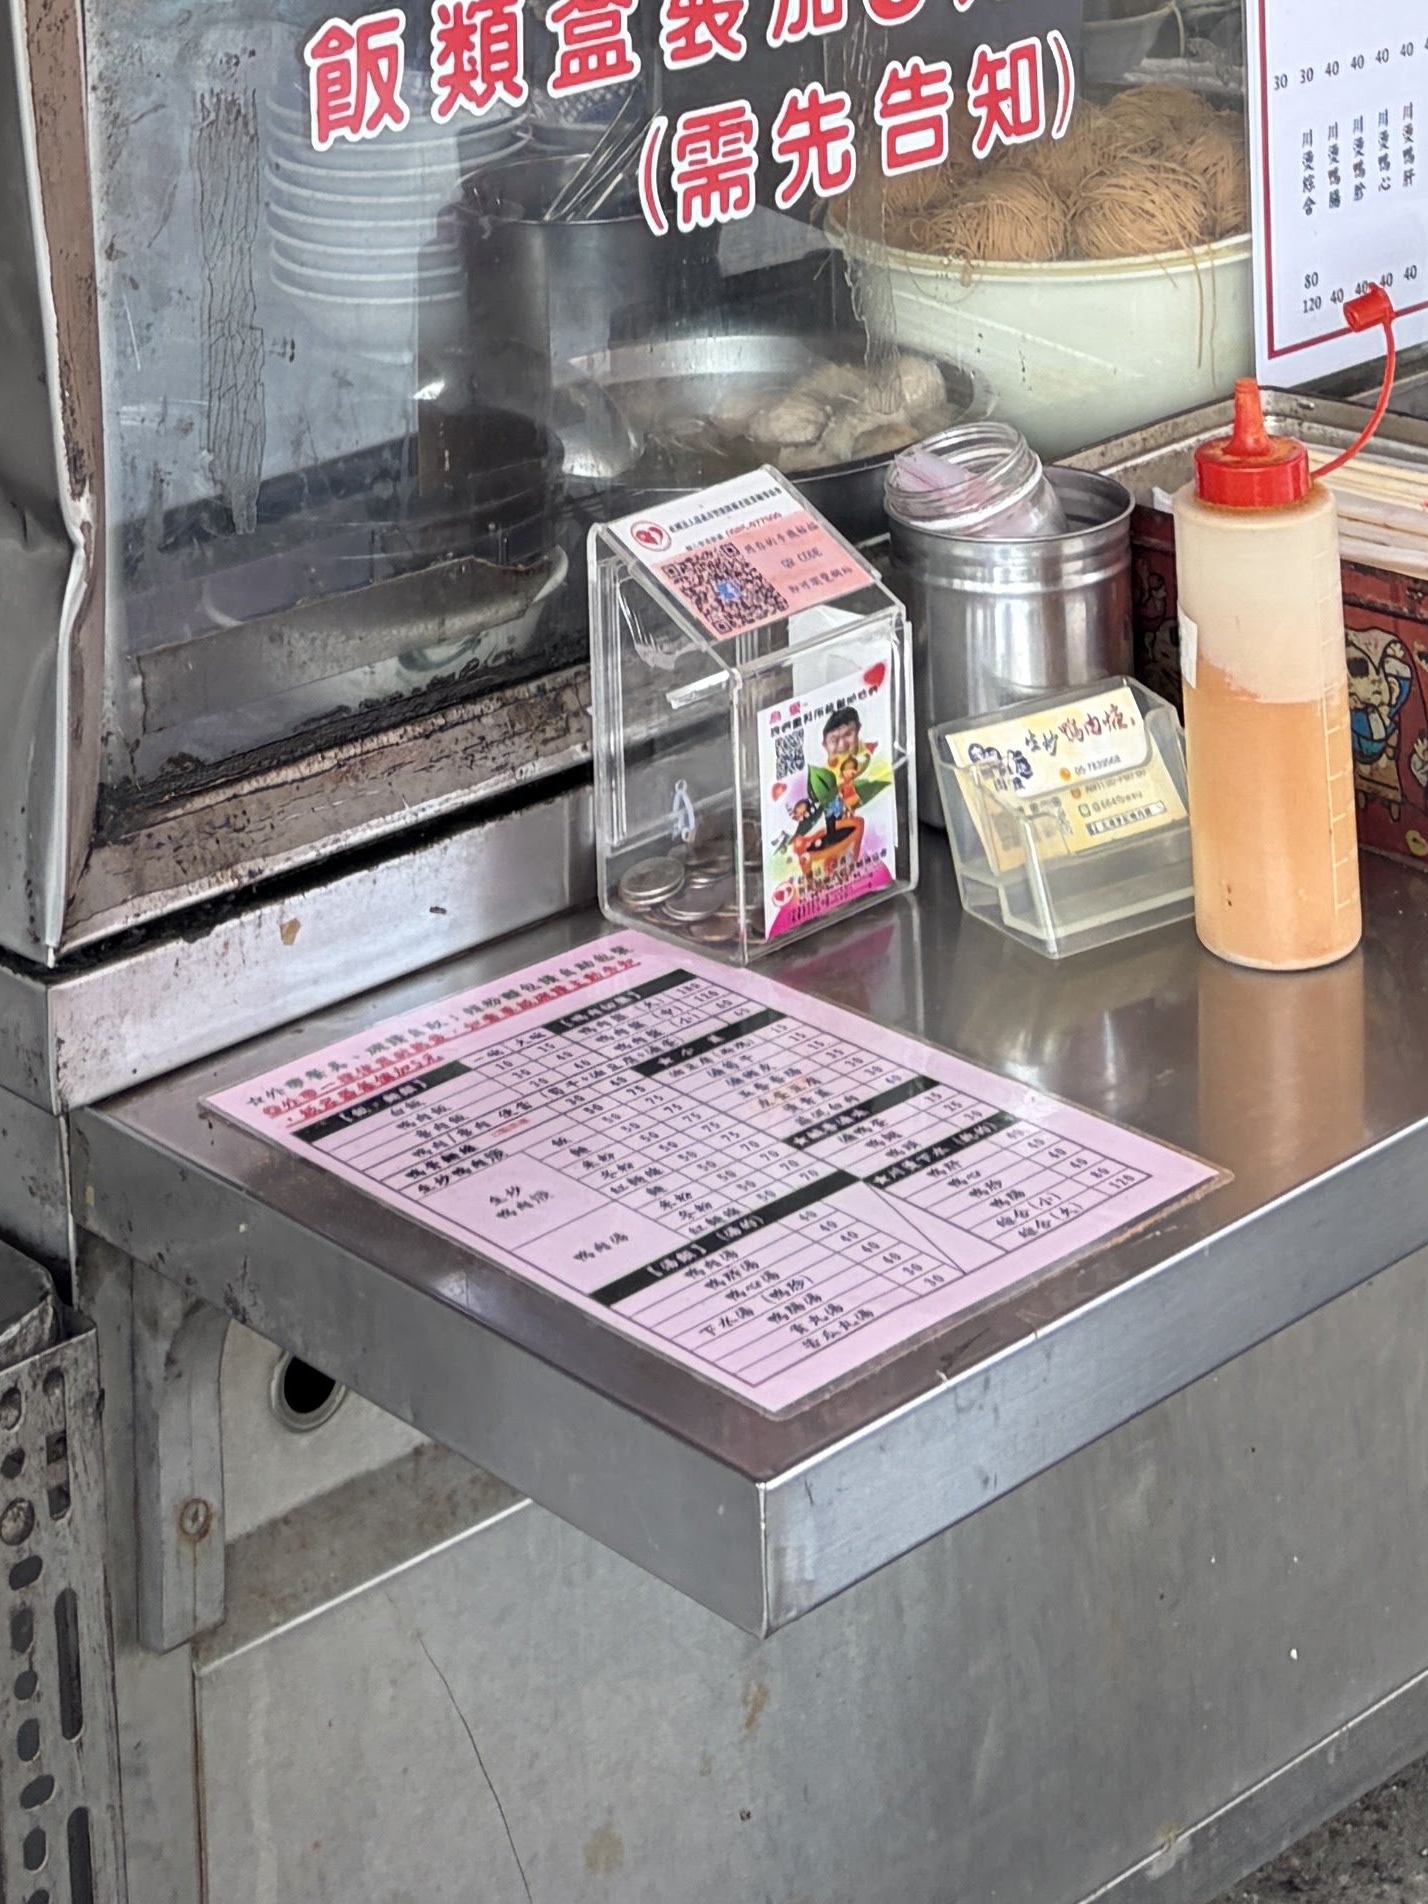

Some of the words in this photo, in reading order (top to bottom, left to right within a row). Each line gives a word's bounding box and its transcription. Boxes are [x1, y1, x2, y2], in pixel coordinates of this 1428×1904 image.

[1273, 74, 1288, 91] 30
[1300, 67, 1314, 84] 30
[1325, 61, 1340, 77] 40
[1350, 54, 1365, 70] 40
[1375, 48, 1389, 64] 40
[1400, 42, 1414, 57] 40
[638, 28, 1074, 236] (需先告知)
[1303, 296, 1322, 314] 120
[1330, 288, 1344, 304] 40
[1379, 272, 1394, 287] 40
[1403, 265, 1418, 281] 40
[1304, 271, 1319, 289] 80
